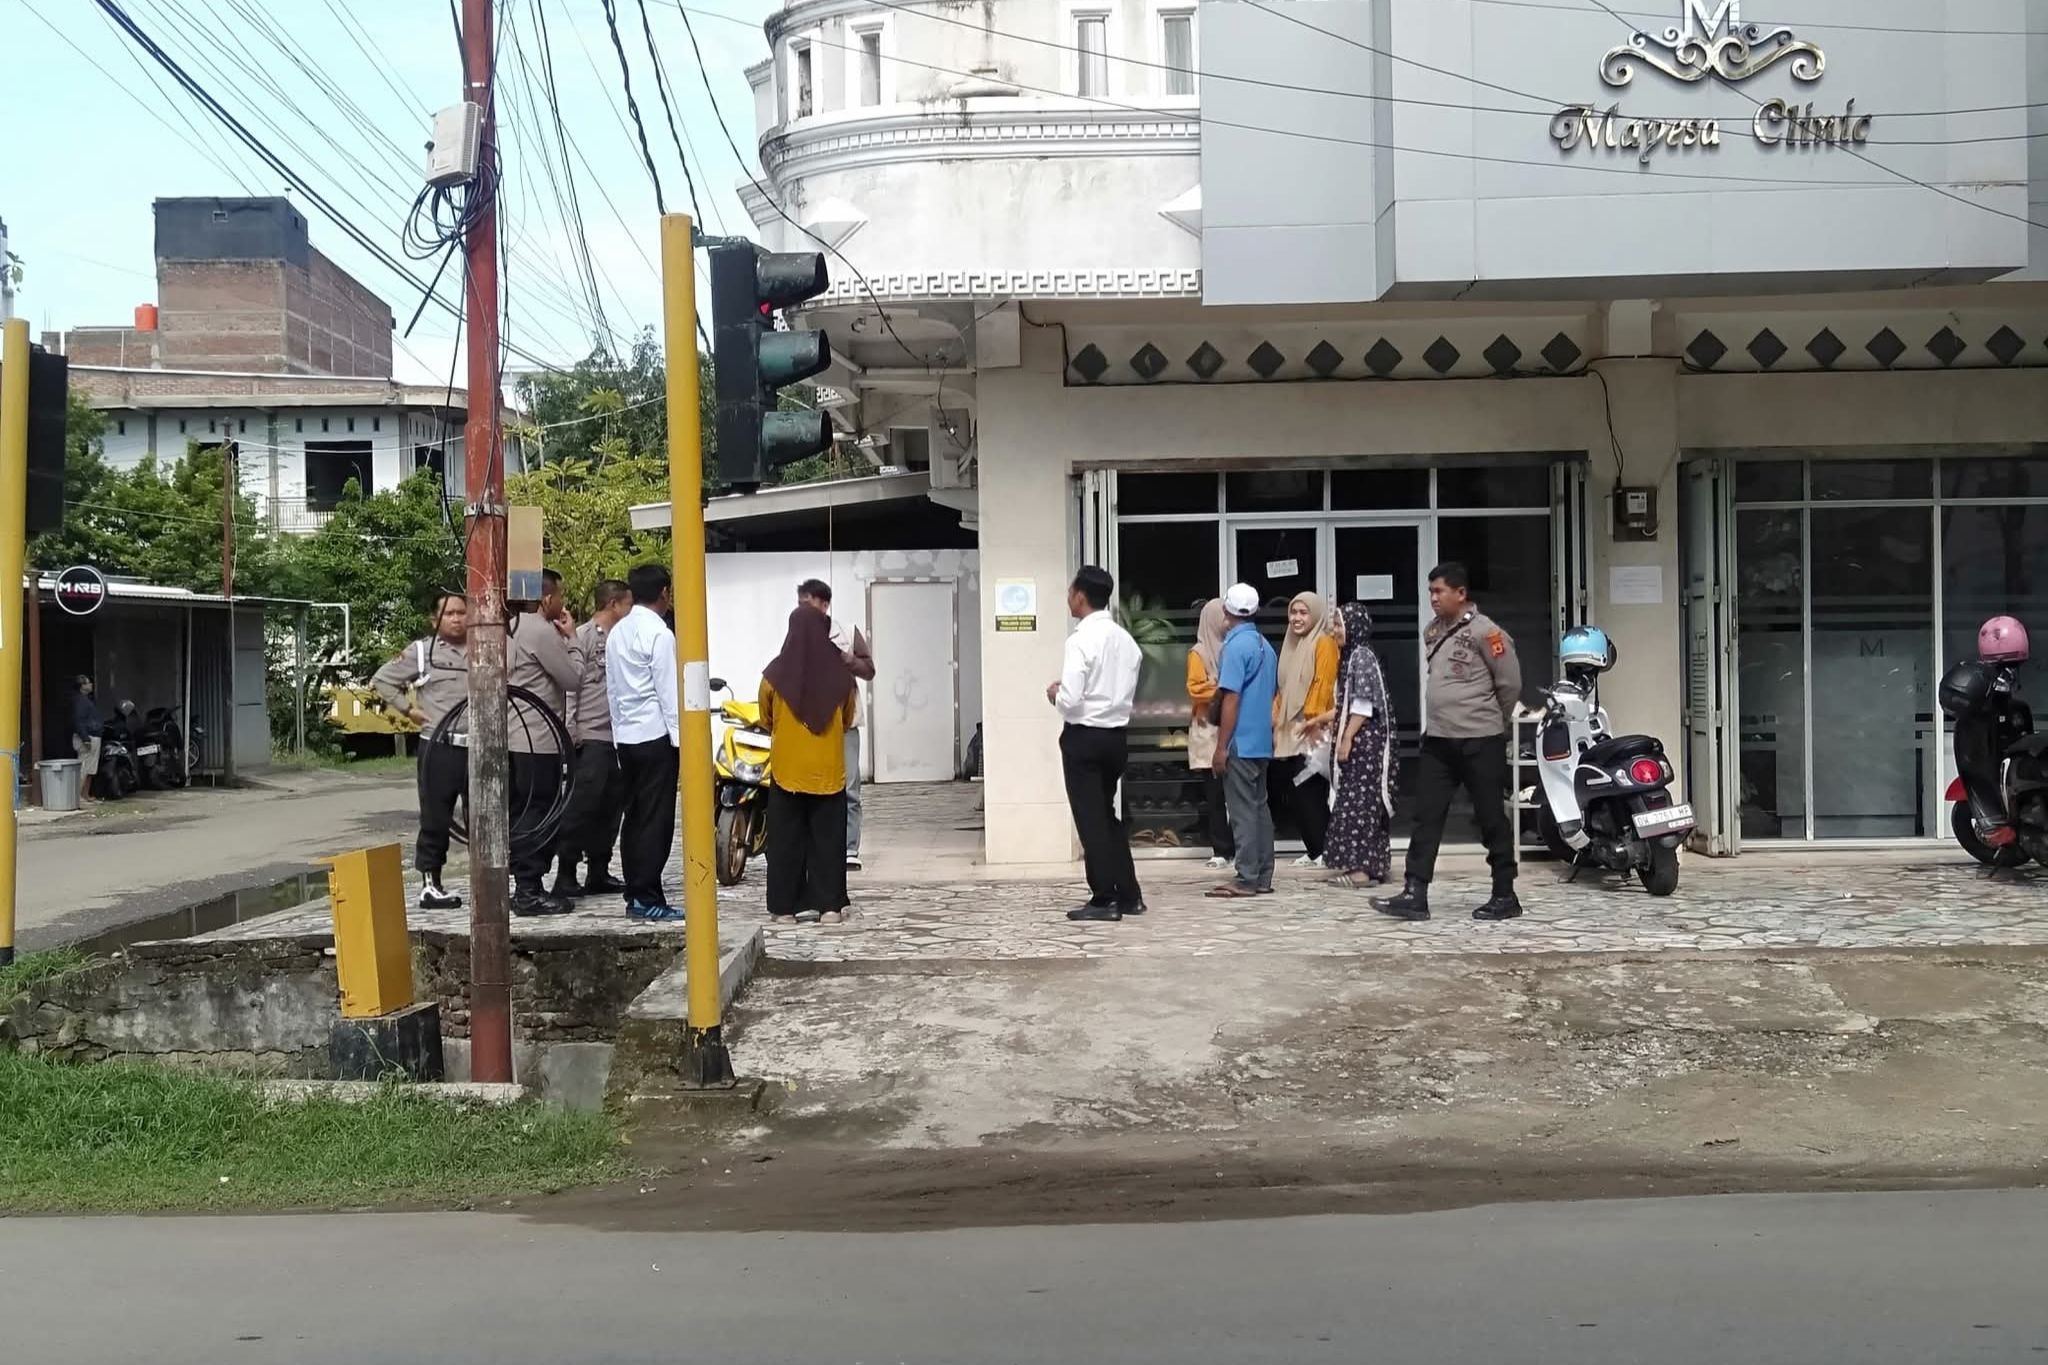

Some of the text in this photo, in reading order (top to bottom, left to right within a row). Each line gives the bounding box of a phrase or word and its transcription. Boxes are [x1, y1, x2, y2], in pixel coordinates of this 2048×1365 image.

[1550, 98, 1872, 163] Mayesa Clinic
[1860, 638, 1884, 657] M
